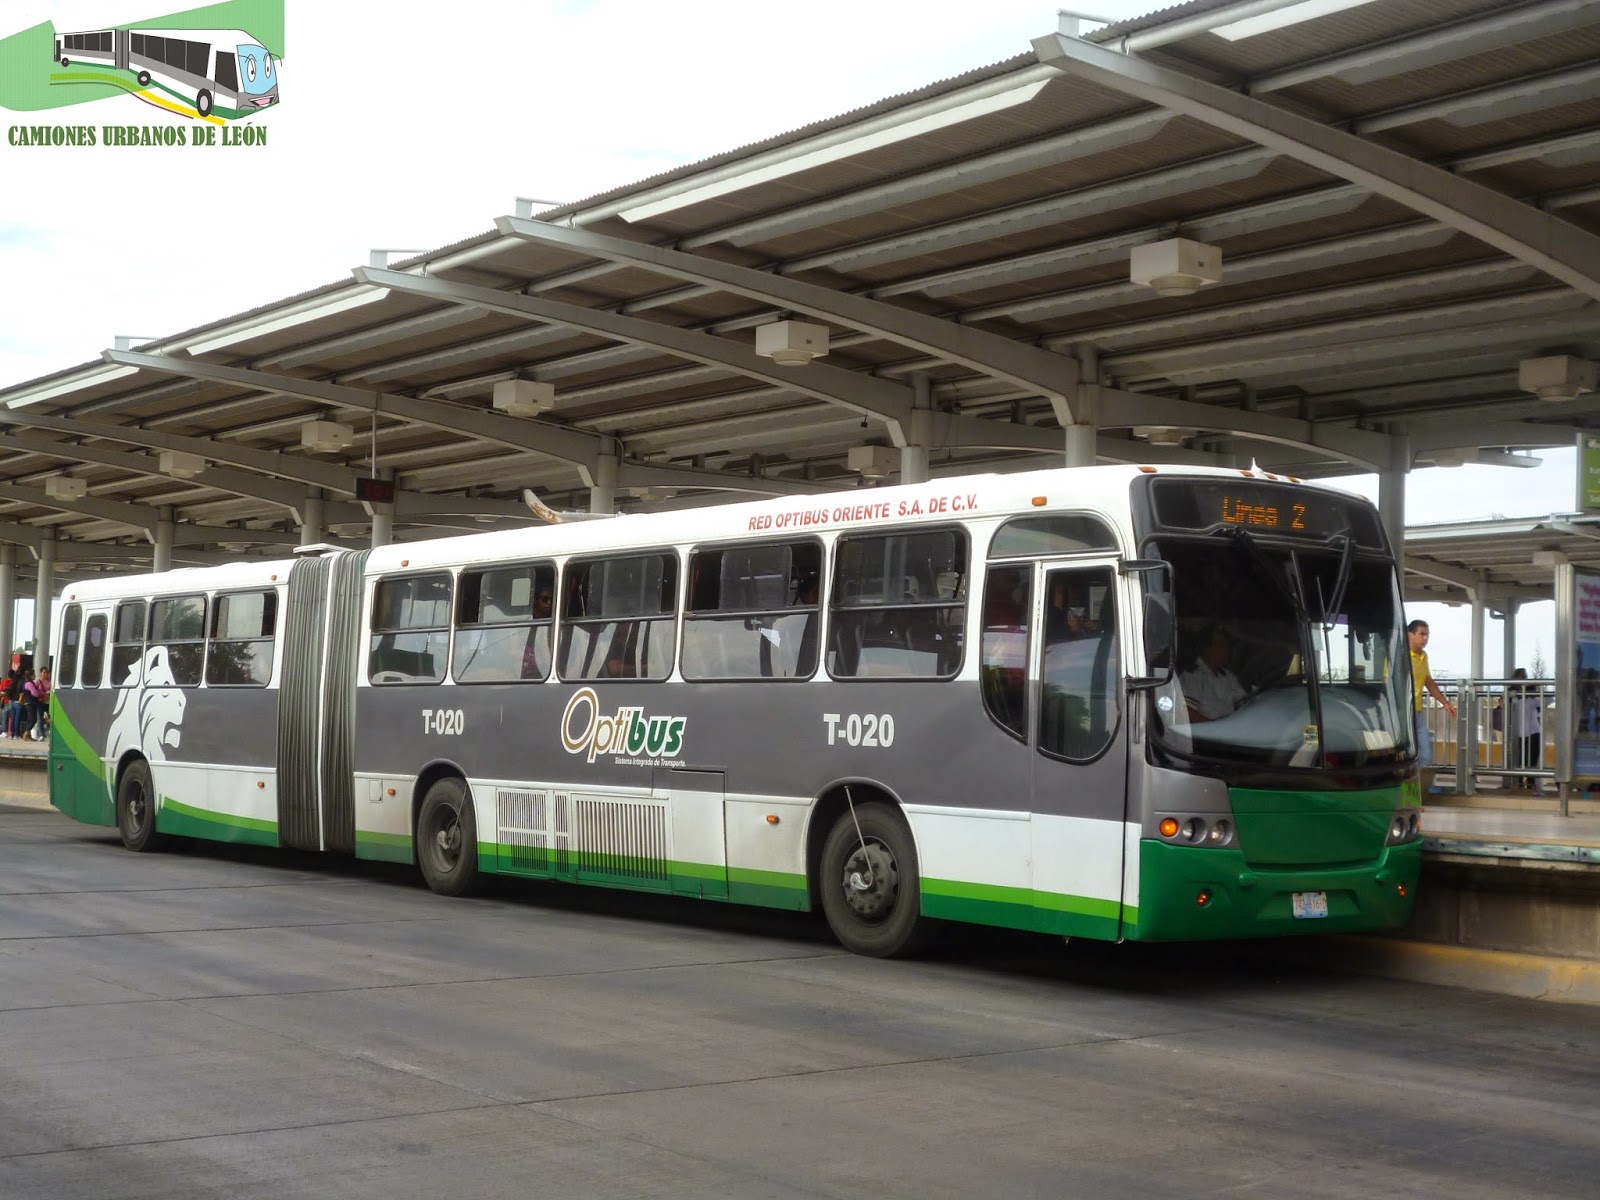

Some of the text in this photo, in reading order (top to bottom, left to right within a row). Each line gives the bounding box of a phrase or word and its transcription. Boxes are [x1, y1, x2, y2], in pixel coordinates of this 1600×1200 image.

[749, 494, 978, 530] RED OPTIBUS ORIENTE S.A. DE C.V.
[1292, 504, 1305, 529] 2
[422, 709, 464, 735] T-020
[561, 687, 687, 763] Optibus
[823, 713, 895, 748] T-020
